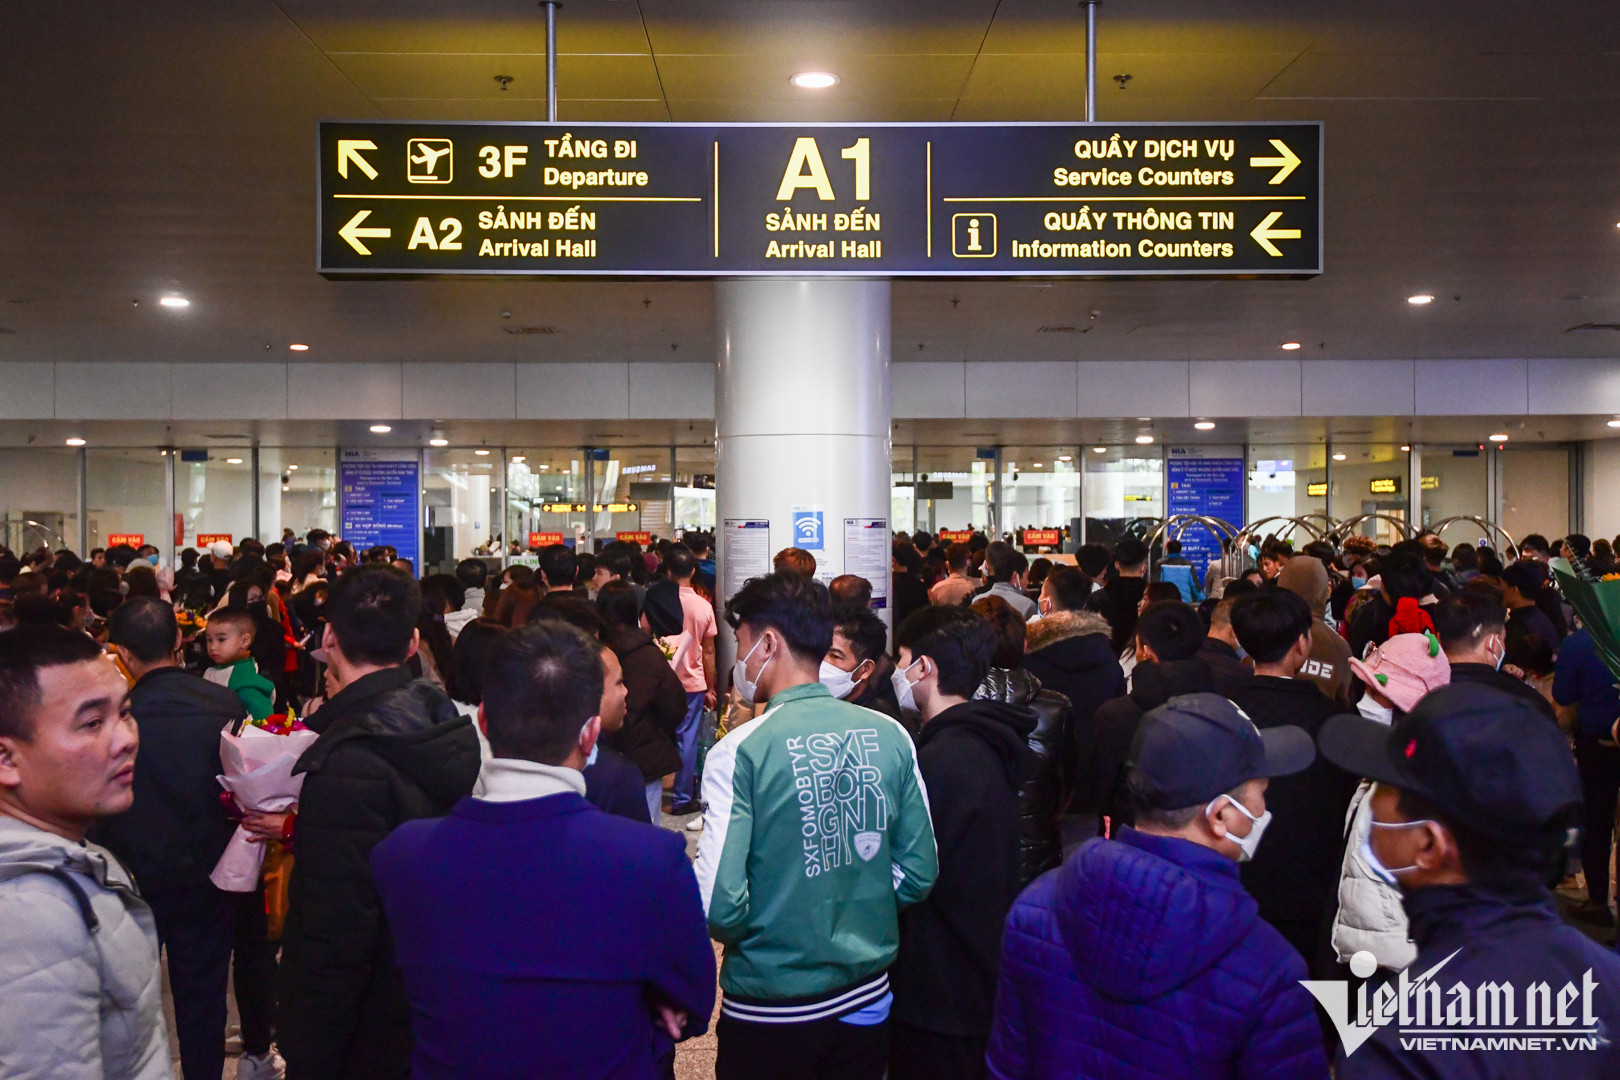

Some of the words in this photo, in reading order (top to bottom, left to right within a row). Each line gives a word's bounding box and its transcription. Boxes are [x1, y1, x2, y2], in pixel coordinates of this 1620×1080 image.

[544, 133, 607, 158] TẦNG
[614, 141, 636, 158] ĐI
[1075, 133, 1137, 158] QUẦY
[1145, 140, 1197, 161] DỊCH
[1204, 140, 1234, 161] VỤ
[478, 145, 528, 178] 3F
[776, 138, 870, 200] A1
[544, 168, 648, 189] Departure
[1054, 168, 1132, 186] Service
[1138, 168, 1234, 186] Counters
[479, 205, 541, 230] SẢNH
[548, 205, 596, 230] ĐẾN
[766, 207, 827, 231] SẢNH
[834, 207, 881, 231] ĐẾN
[1044, 205, 1107, 231] QUẦY
[1113, 208, 1191, 230] THÔNG
[1198, 212, 1234, 229] TIN
[407, 217, 462, 250] A2
[479, 239, 548, 257] Arrival
[556, 240, 597, 257] Hall
[765, 241, 834, 258] Arrival
[842, 241, 881, 258] Hall
[1013, 240, 1131, 258] Information
[1138, 239, 1234, 258] Counters
[806, 729, 879, 773] SXF
[813, 766, 885, 808] BOR
